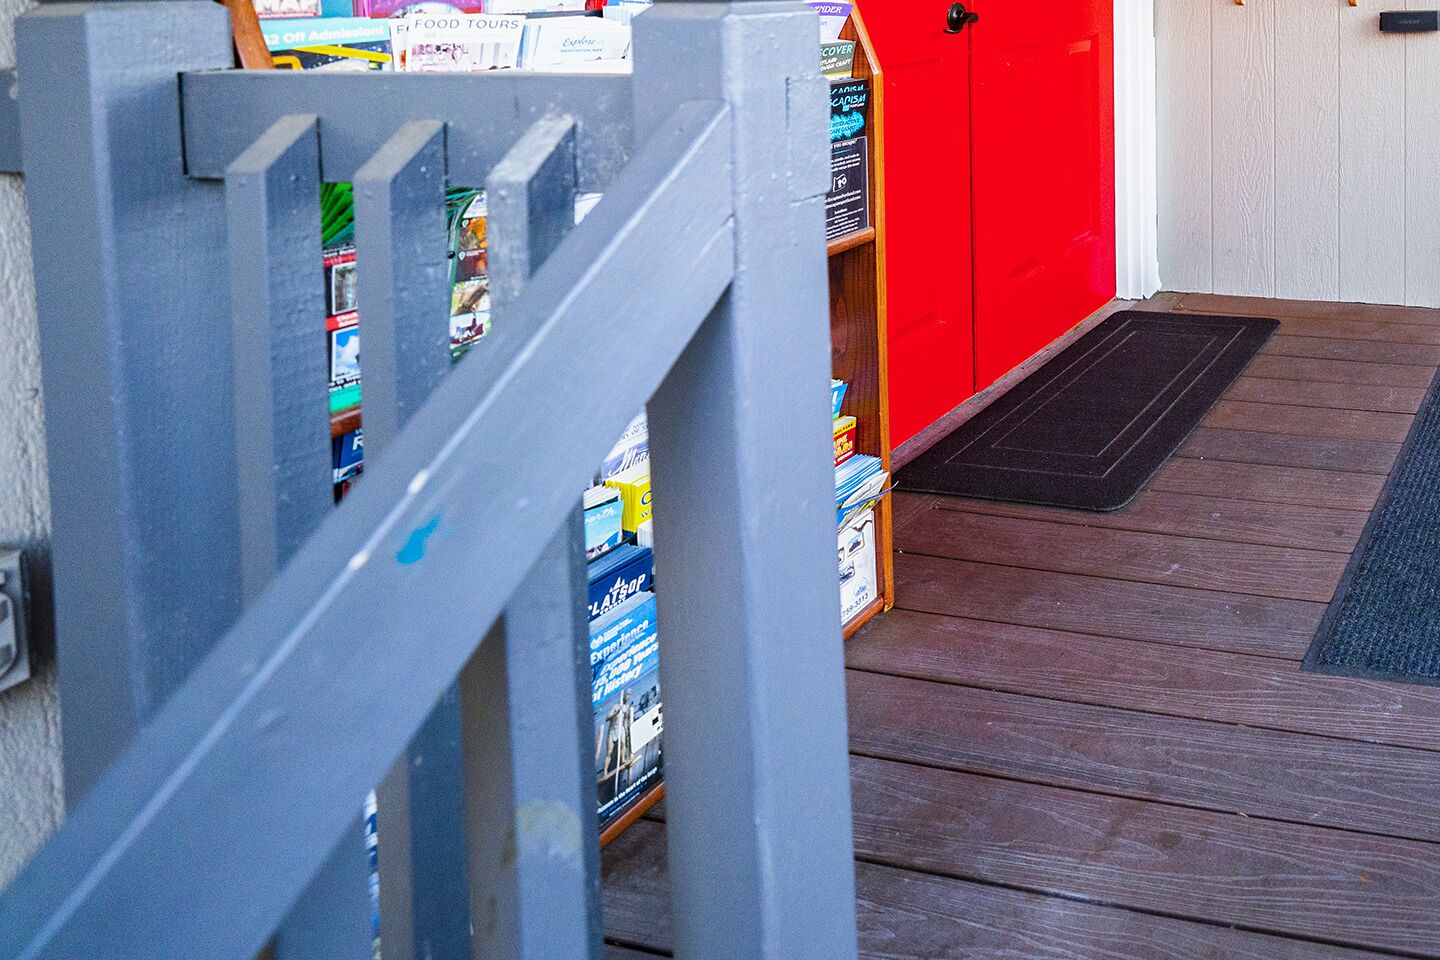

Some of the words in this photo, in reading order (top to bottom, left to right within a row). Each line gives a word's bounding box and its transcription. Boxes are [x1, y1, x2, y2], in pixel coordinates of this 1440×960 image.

[414, 18, 461, 29] FOOD
[466, 18, 519, 29] TOURS
[283, 31, 307, 44] Off
[820, 44, 852, 57] COVER
[590, 619, 649, 665] Experience
